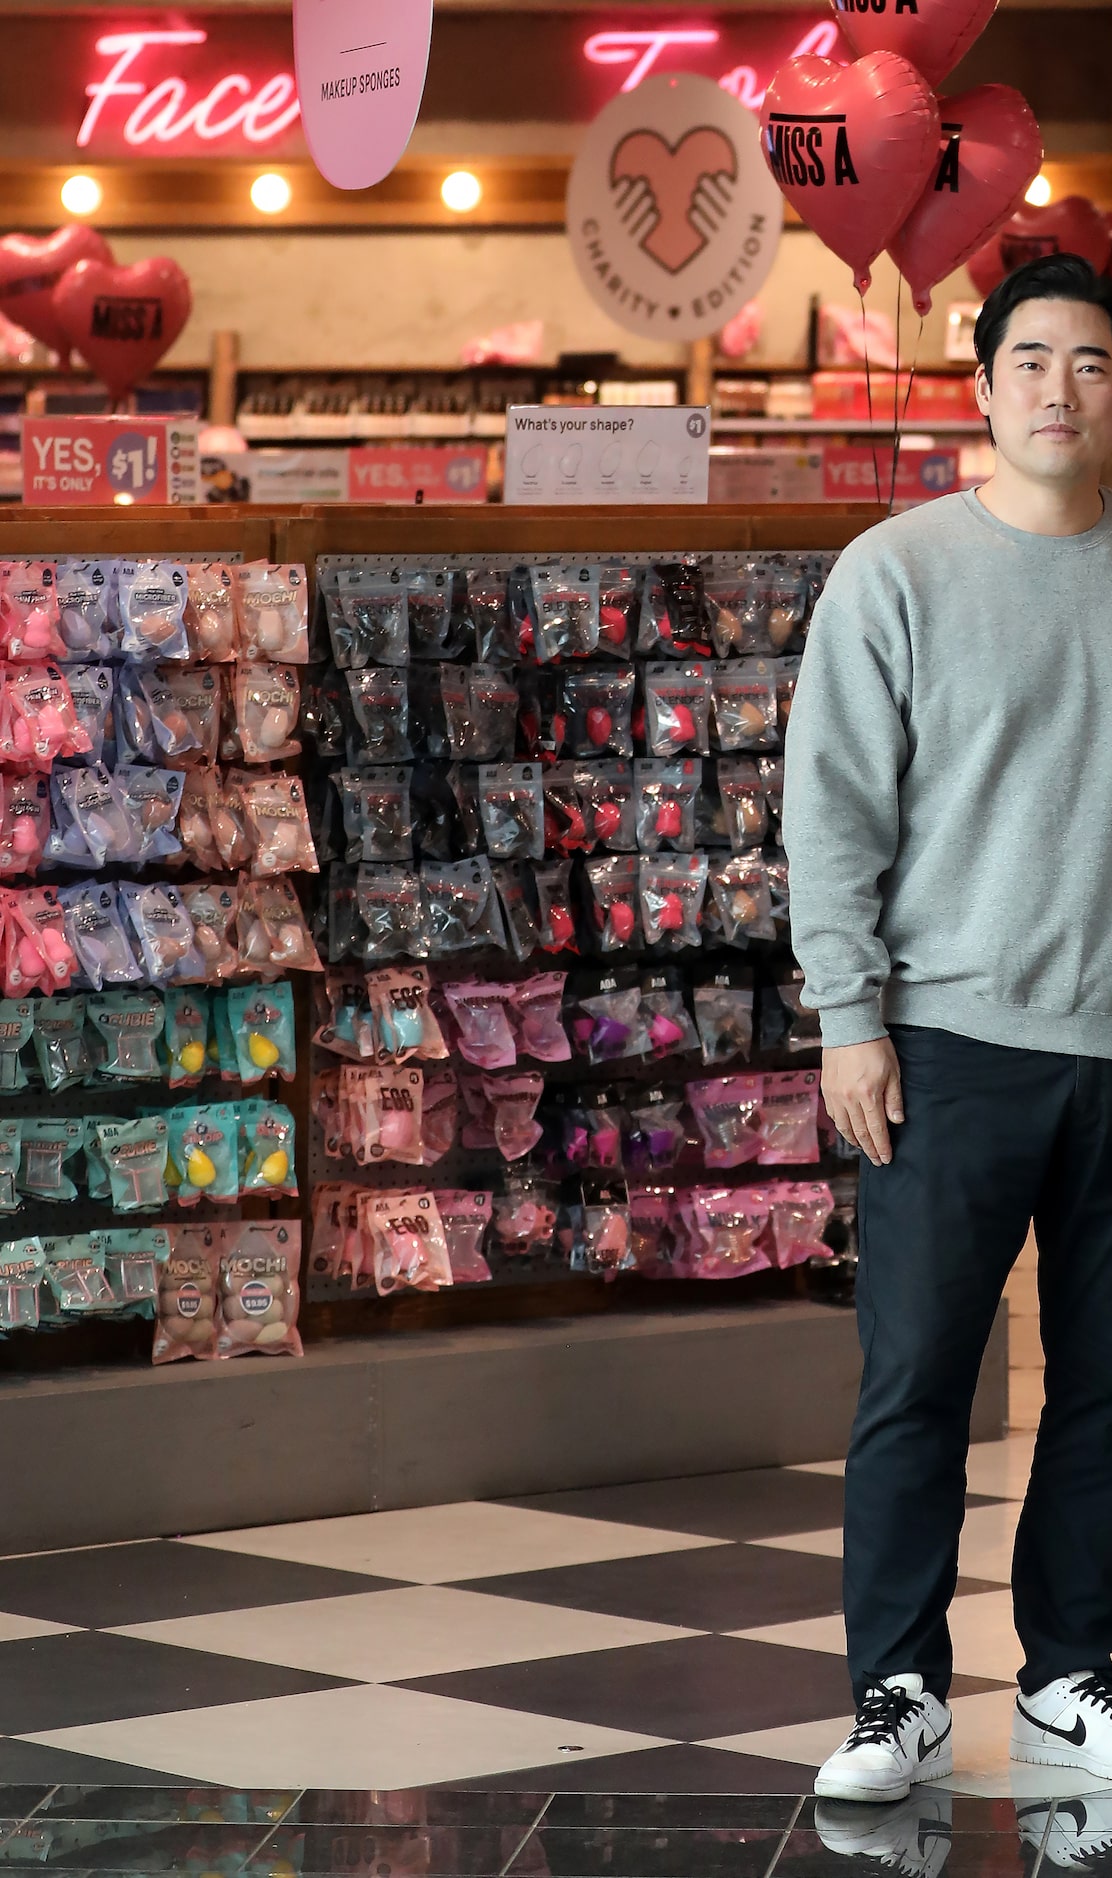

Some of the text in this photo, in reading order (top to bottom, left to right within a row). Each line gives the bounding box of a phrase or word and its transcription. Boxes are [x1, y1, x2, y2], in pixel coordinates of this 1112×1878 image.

[77, 31, 299, 147] Face
[320, 67, 401, 101] MAKEUP SPONGES
[768, 125, 860, 187] MISS A
[582, 213, 767, 320] CHARITY EDITION
[515, 418, 635, 434] What's your shape?
[32, 436, 102, 477] YES,
[111, 435, 159, 489] $1!
[33, 476, 94, 491] IT'S ONLY
[245, 590, 297, 605] MOCHI
[600, 977, 617, 990] AOA
[103, 1127, 119, 1138] AOA
[220, 1256, 287, 1274] MOCHI
